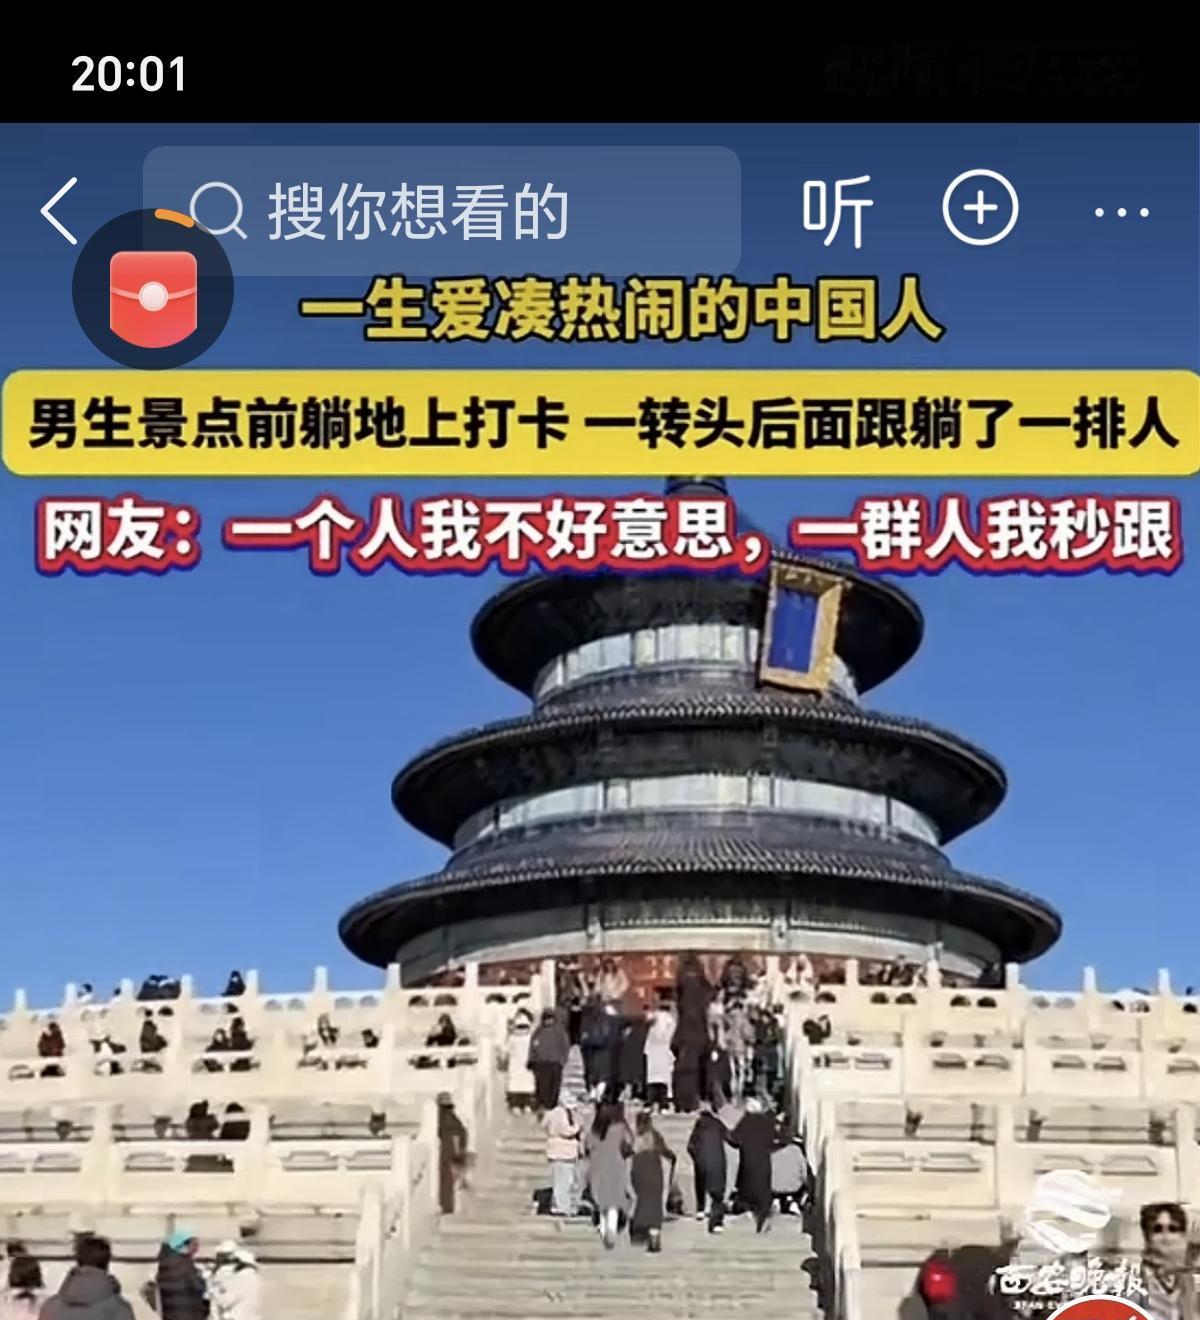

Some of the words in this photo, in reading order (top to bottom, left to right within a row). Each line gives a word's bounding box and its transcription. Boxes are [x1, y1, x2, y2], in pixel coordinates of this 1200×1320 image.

[71, 55, 184, 92] 20:01
[267, 182, 569, 242] 搜你想看的
[803, 175, 874, 249] 听
